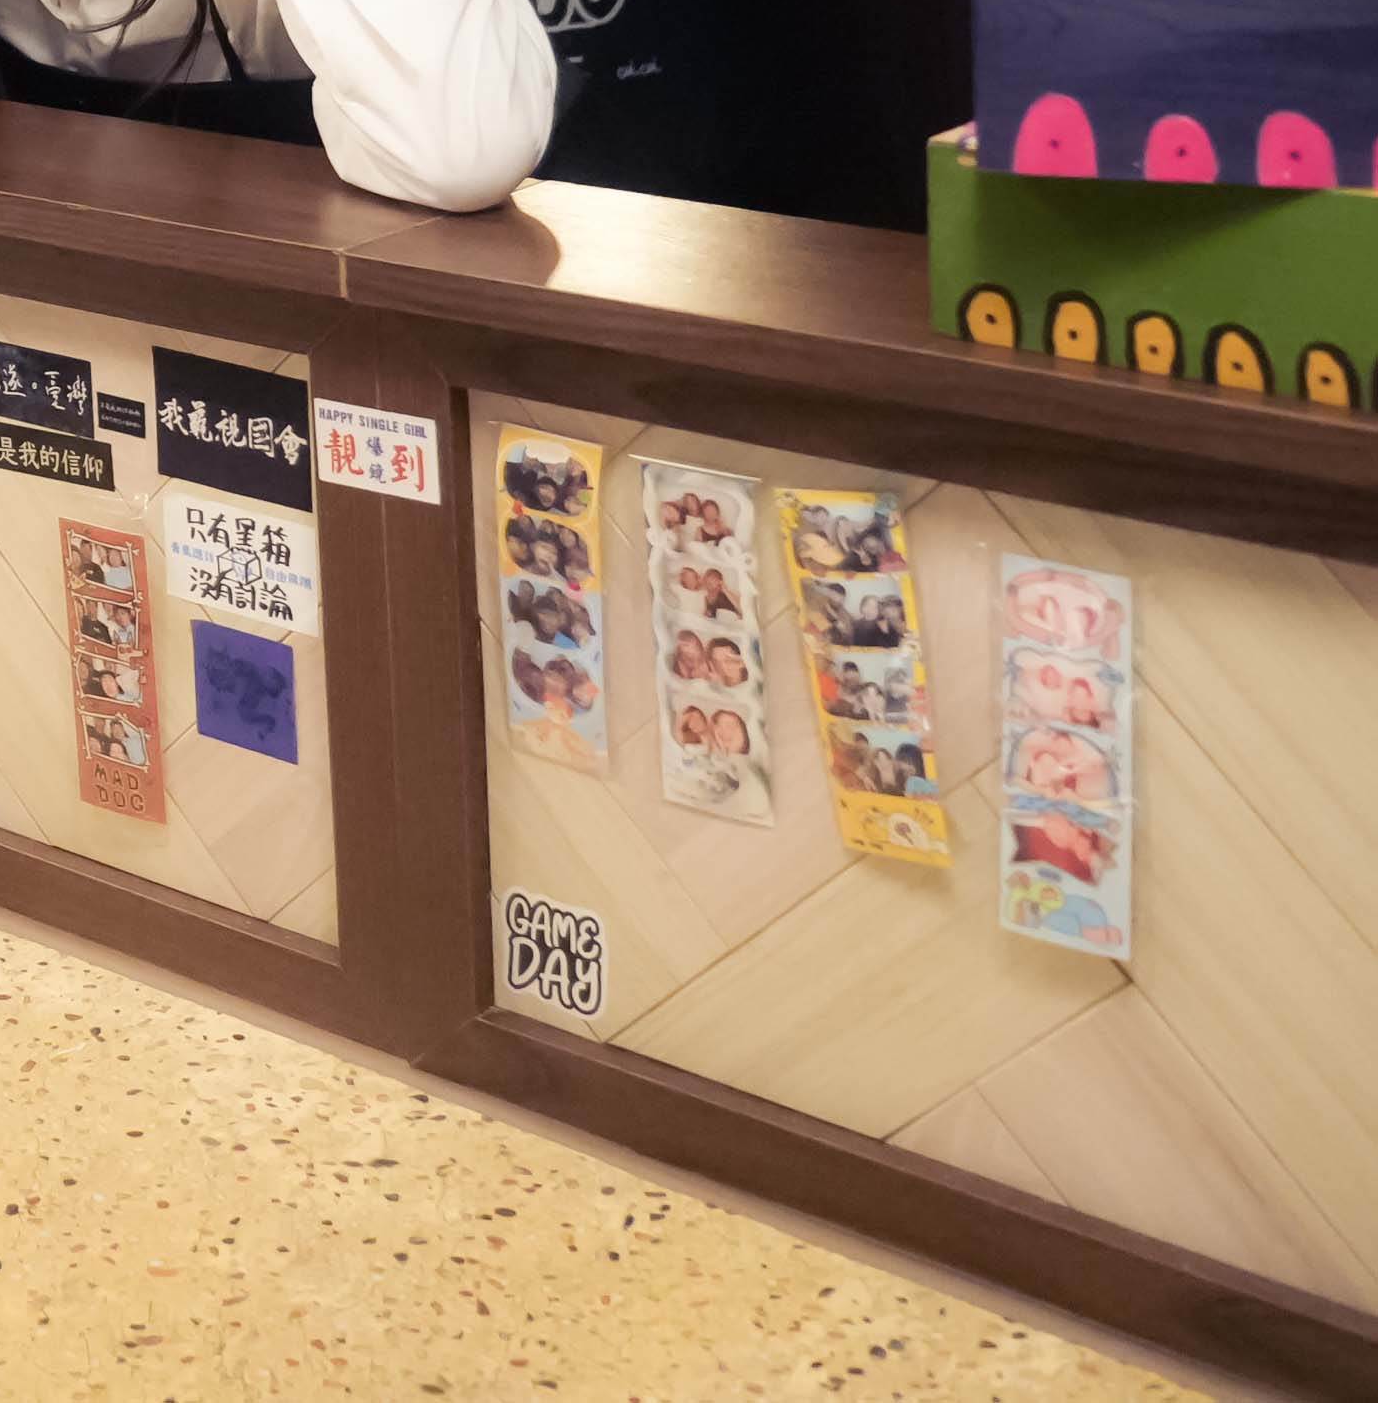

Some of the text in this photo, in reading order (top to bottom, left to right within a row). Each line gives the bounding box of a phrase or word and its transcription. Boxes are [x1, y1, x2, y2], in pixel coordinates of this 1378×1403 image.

[318, 407, 428, 439] HAPPY SINGLE GIRL
[186, 506, 291, 567] 只有黑箱
[189, 566, 294, 621] 沒有討論
[94, 763, 139, 790] MAD
[94, 784, 145, 812] DOG
[506, 893, 602, 960] GAME
[507, 935, 602, 1015] DAY
